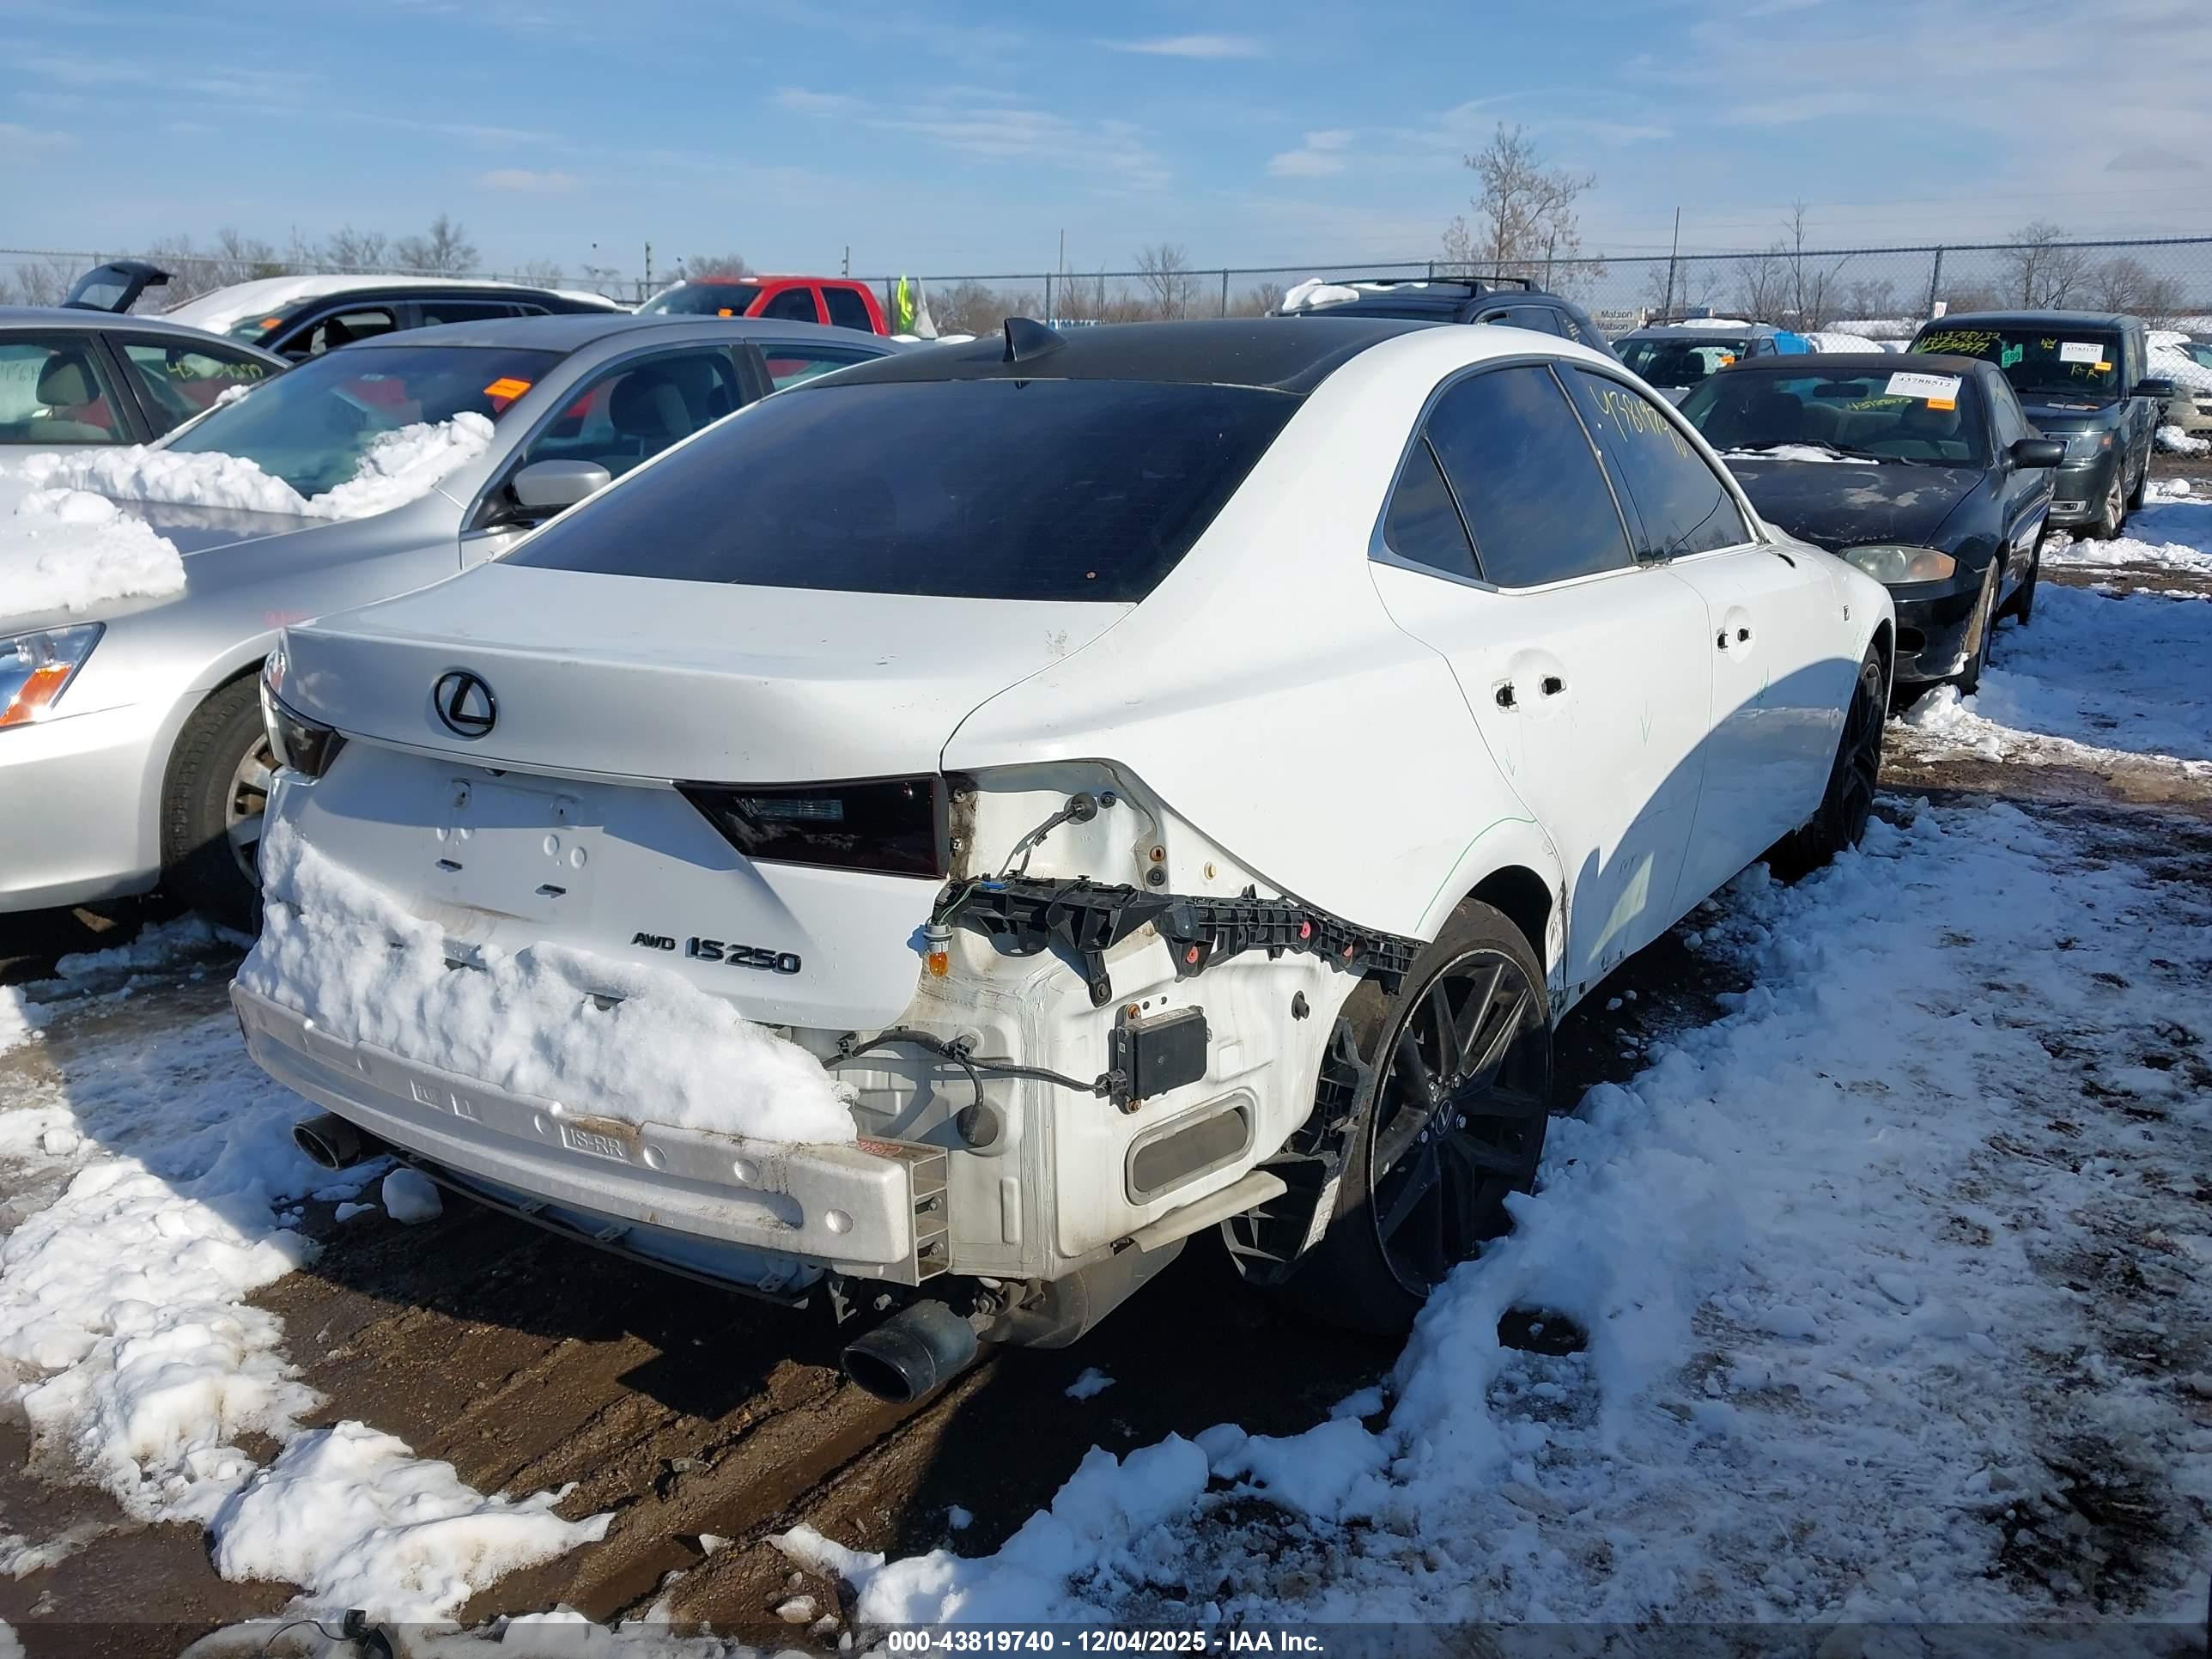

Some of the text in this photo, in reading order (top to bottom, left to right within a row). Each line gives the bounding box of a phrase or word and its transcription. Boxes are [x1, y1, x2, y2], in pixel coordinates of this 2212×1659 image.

[1601, 310, 1632, 319] Matson
[1898, 377, 1952, 387] 43788512
[630, 932, 802, 975] AWD IS 250
[569, 1127, 623, 1157] IS-RR
